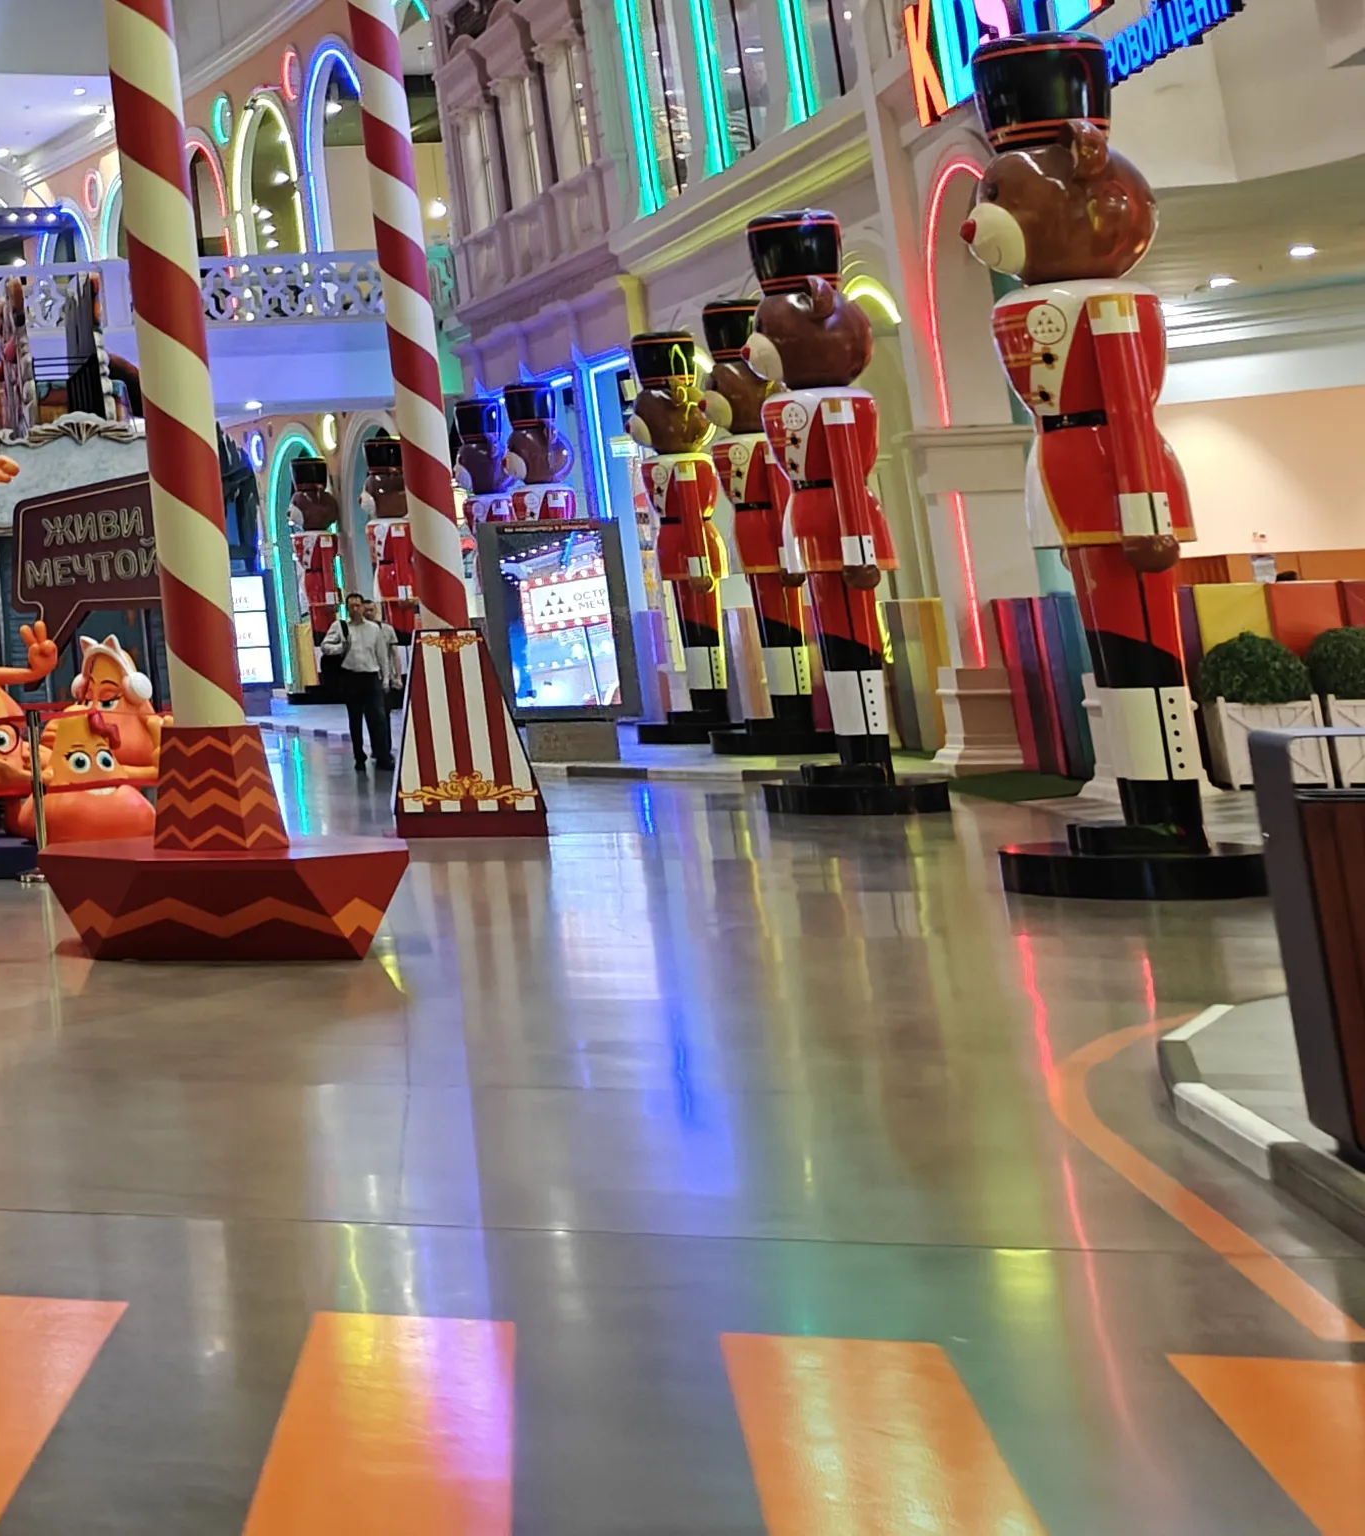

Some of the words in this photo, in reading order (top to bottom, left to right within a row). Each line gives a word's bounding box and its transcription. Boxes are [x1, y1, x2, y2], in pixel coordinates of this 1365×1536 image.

[1104, 0, 1169, 84] РОВОЙ
[41, 506, 145, 547] ЖИВИ
[25, 536, 160, 589] МЕЧТОЙ
